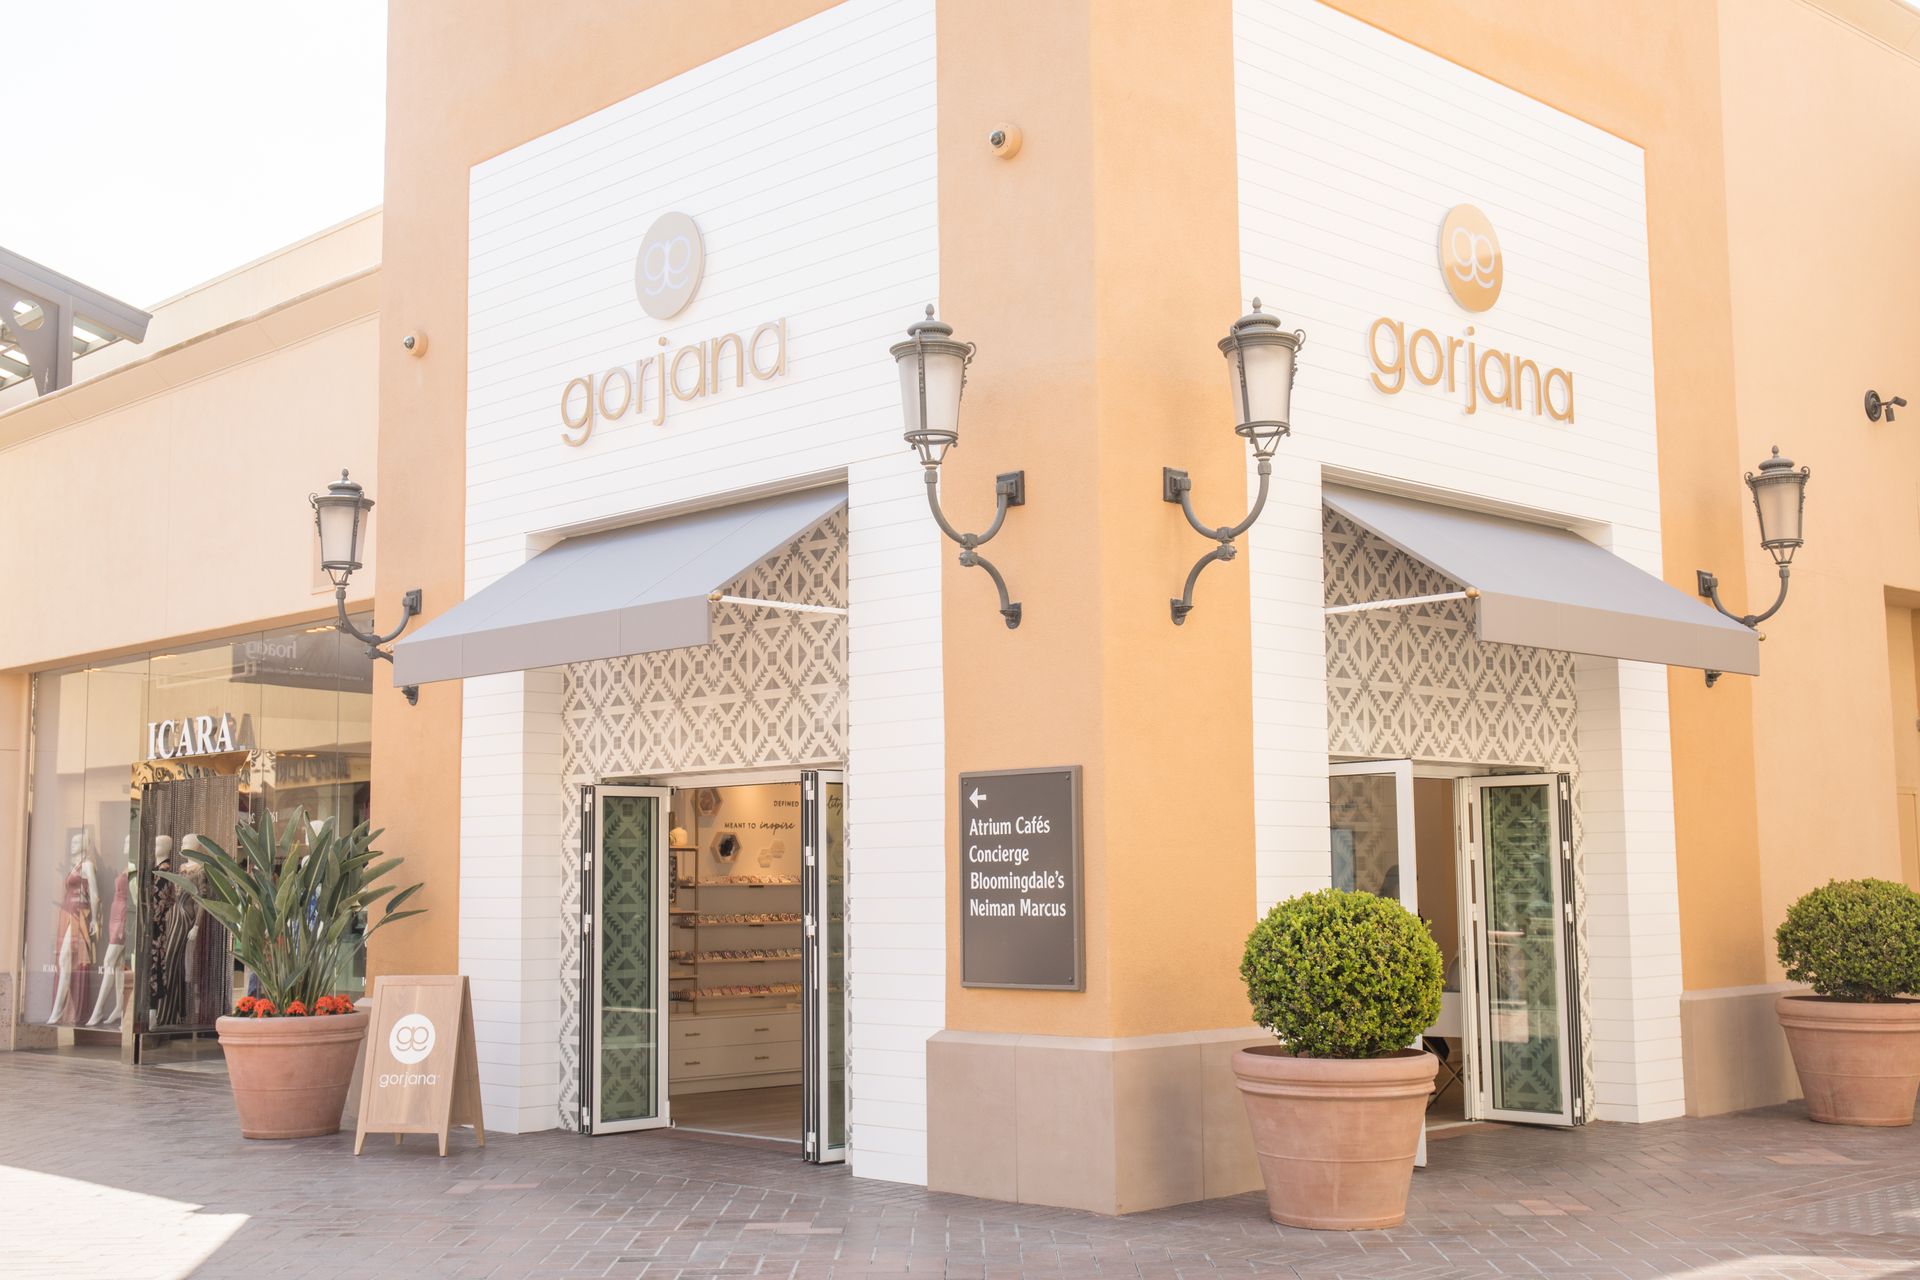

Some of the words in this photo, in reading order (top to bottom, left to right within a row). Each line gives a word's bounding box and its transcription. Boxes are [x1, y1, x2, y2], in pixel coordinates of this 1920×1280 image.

[1369, 317, 1574, 424] gorjana
[561, 317, 786, 447] gorjana
[147, 712, 234, 760] ICARA
[773, 800, 800, 808] DEFINED
[759, 822, 796, 835] inspire
[969, 818, 1012, 836] Atrium
[1015, 816, 1050, 834] Cafés
[969, 845, 1030, 865] Concierge
[970, 871, 1065, 893] Bloomingdale's
[970, 898, 1016, 916] Neiman
[1020, 898, 1067, 917] Marcus
[379, 1072, 436, 1088] gorjana
